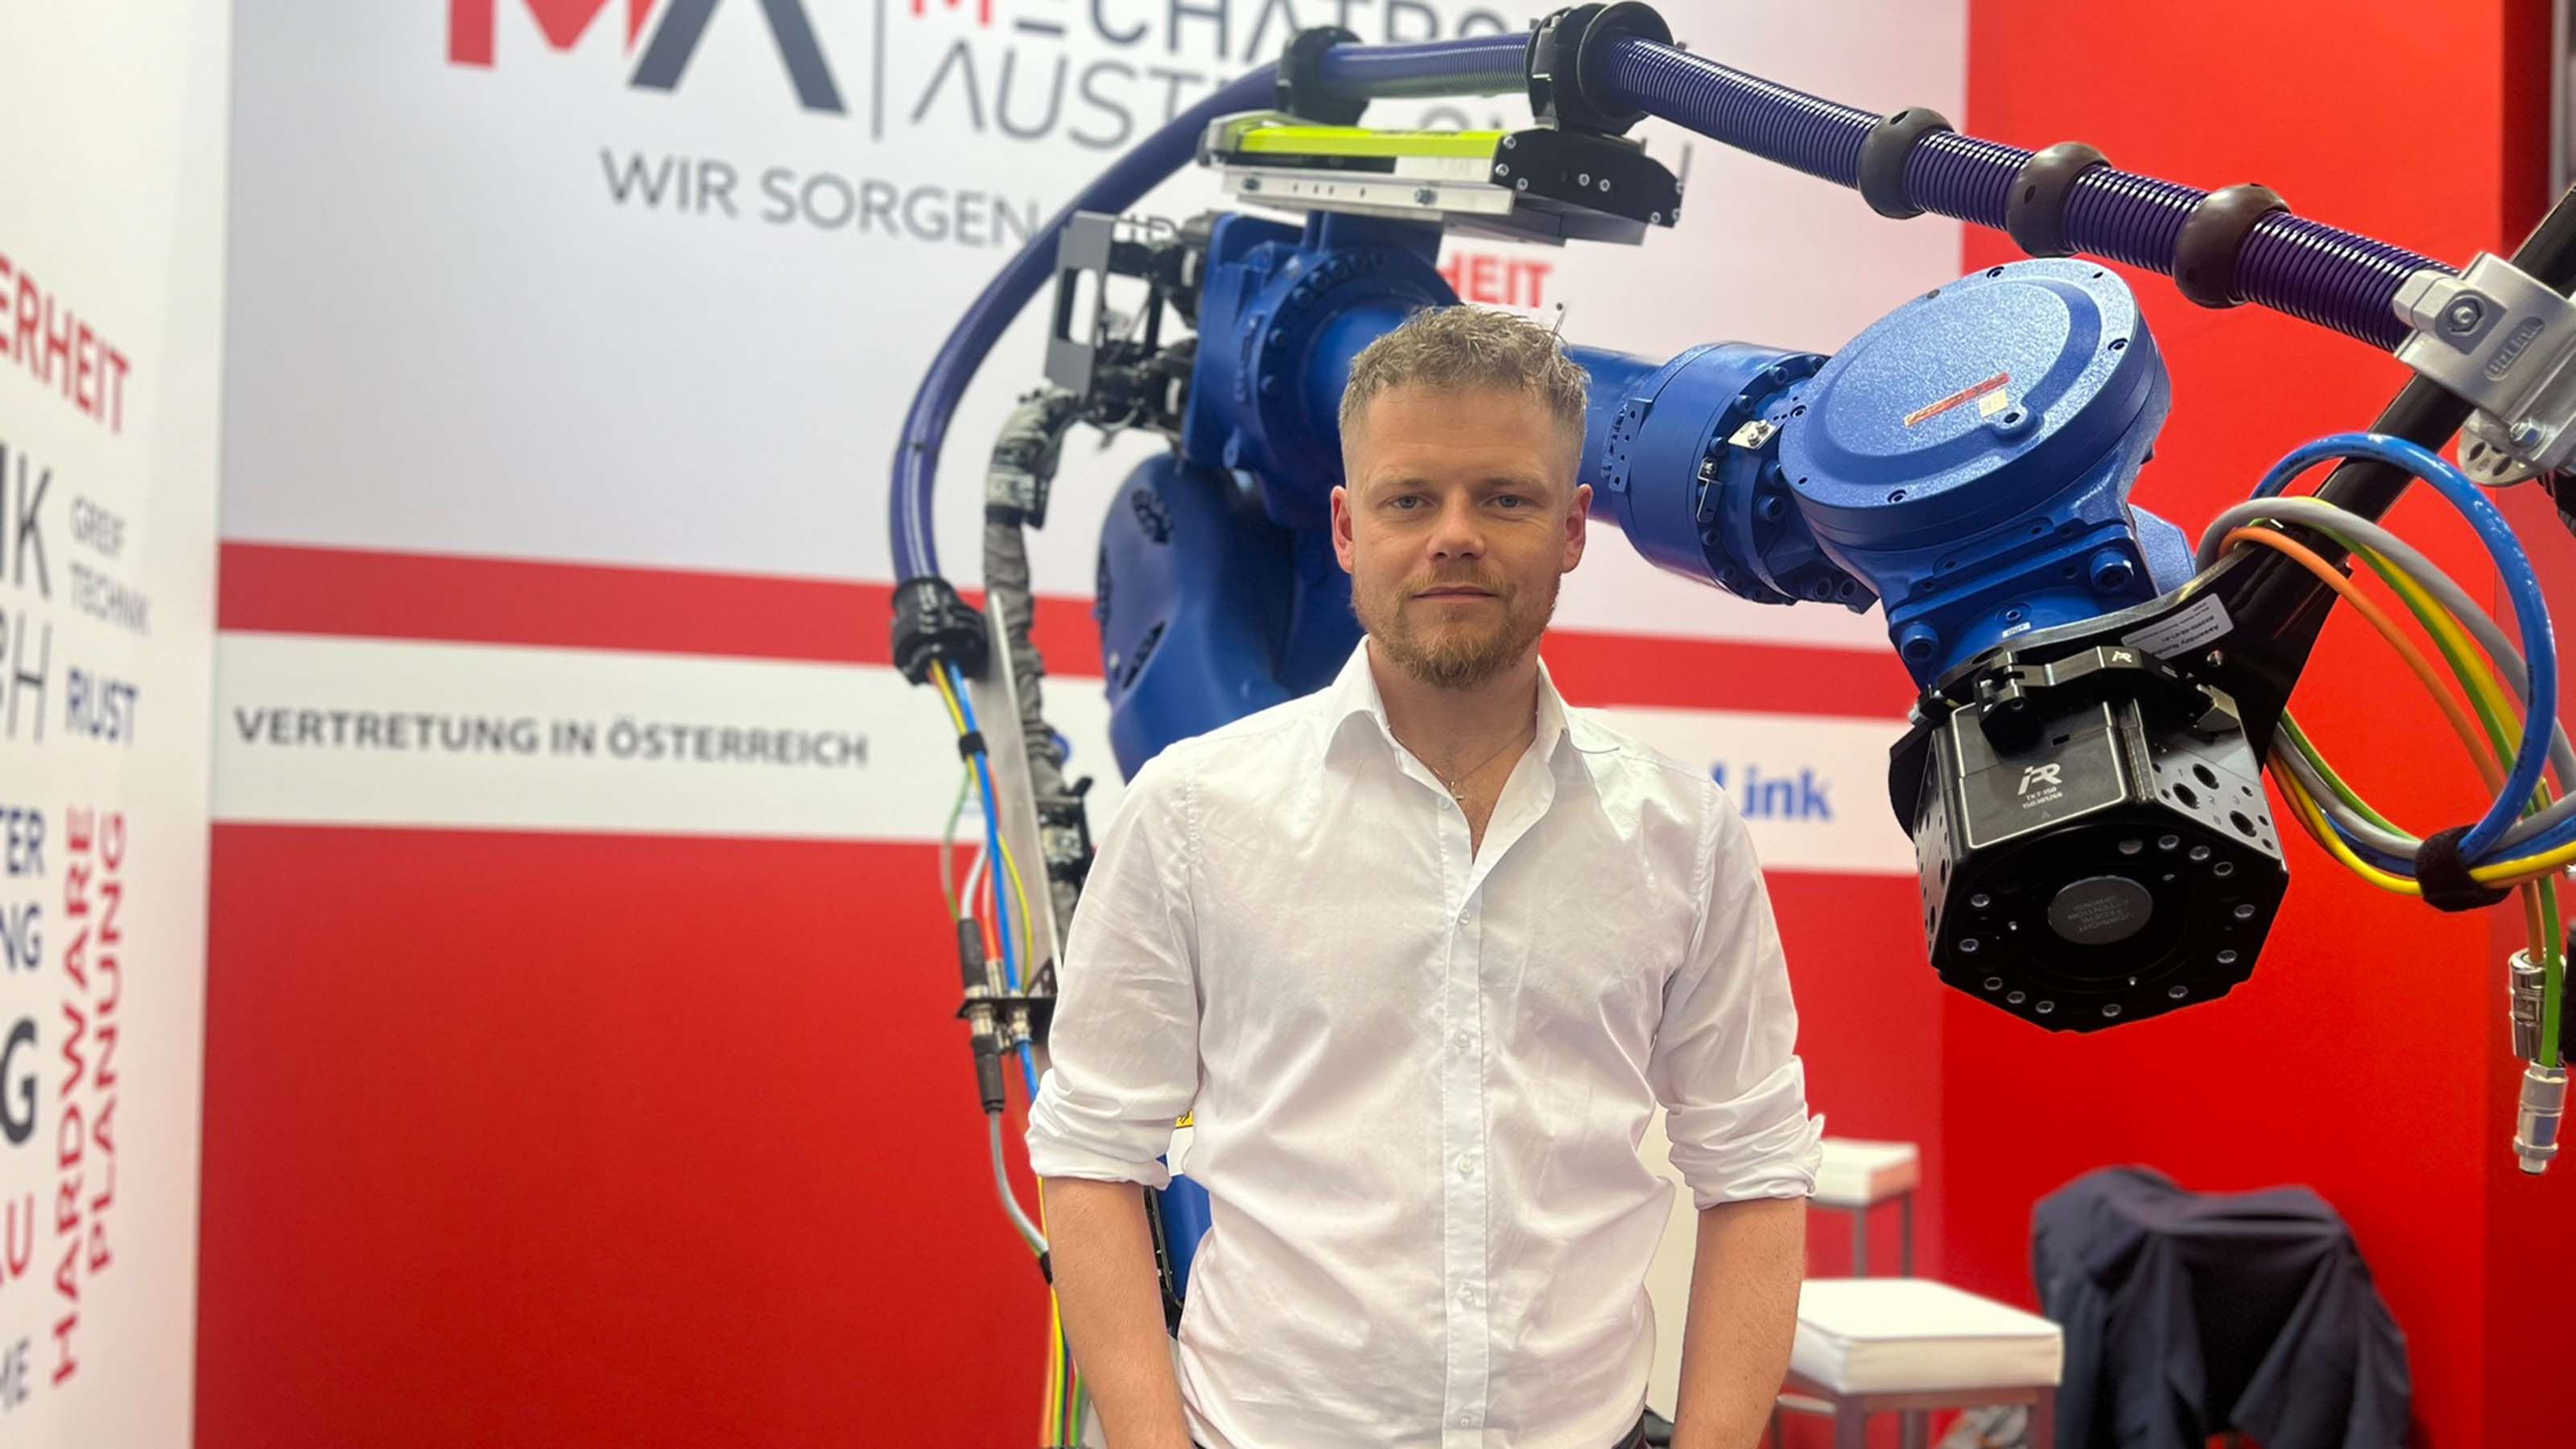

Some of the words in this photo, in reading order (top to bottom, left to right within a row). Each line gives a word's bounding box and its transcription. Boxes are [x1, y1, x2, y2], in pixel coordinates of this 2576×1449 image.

[599, 147, 739, 219] WIR
[759, 166, 1040, 248] SORGEN
[66, 667, 138, 747] RUST
[233, 707, 539, 755] VERTRETUNG
[551, 719, 597, 755] IN
[608, 715, 869, 769] ÖSTERREICH
[1709, 761, 1832, 820] ink
[85, 809, 128, 1277] PLANUNG
[50, 802, 96, 1389] HARDWARE
